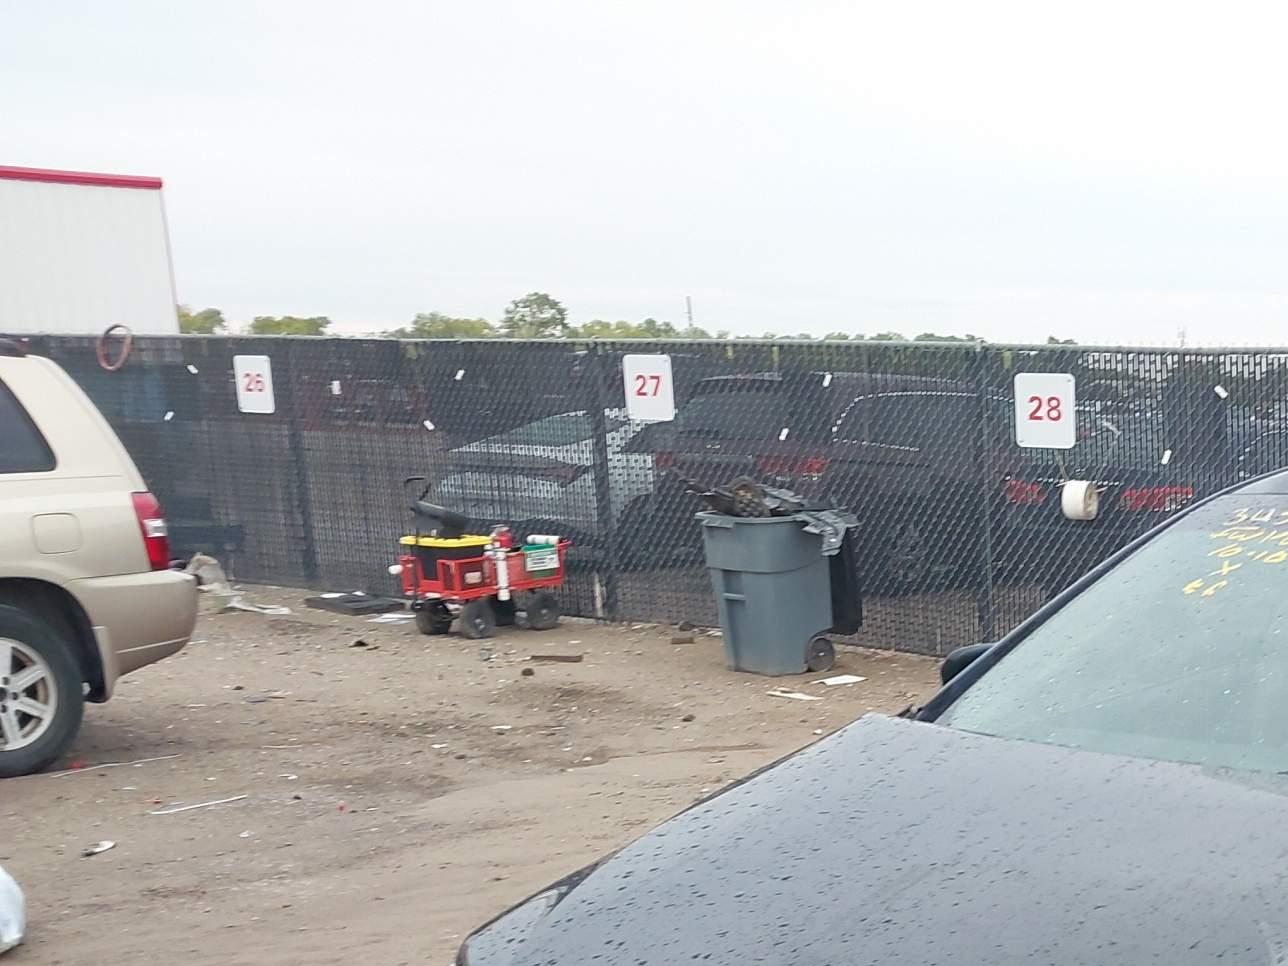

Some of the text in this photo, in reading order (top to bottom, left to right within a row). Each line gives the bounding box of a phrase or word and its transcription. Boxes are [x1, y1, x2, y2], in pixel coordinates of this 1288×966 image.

[243, 373, 265, 392] 26
[634, 374, 663, 398] 27
[1027, 395, 1062, 423] 28
